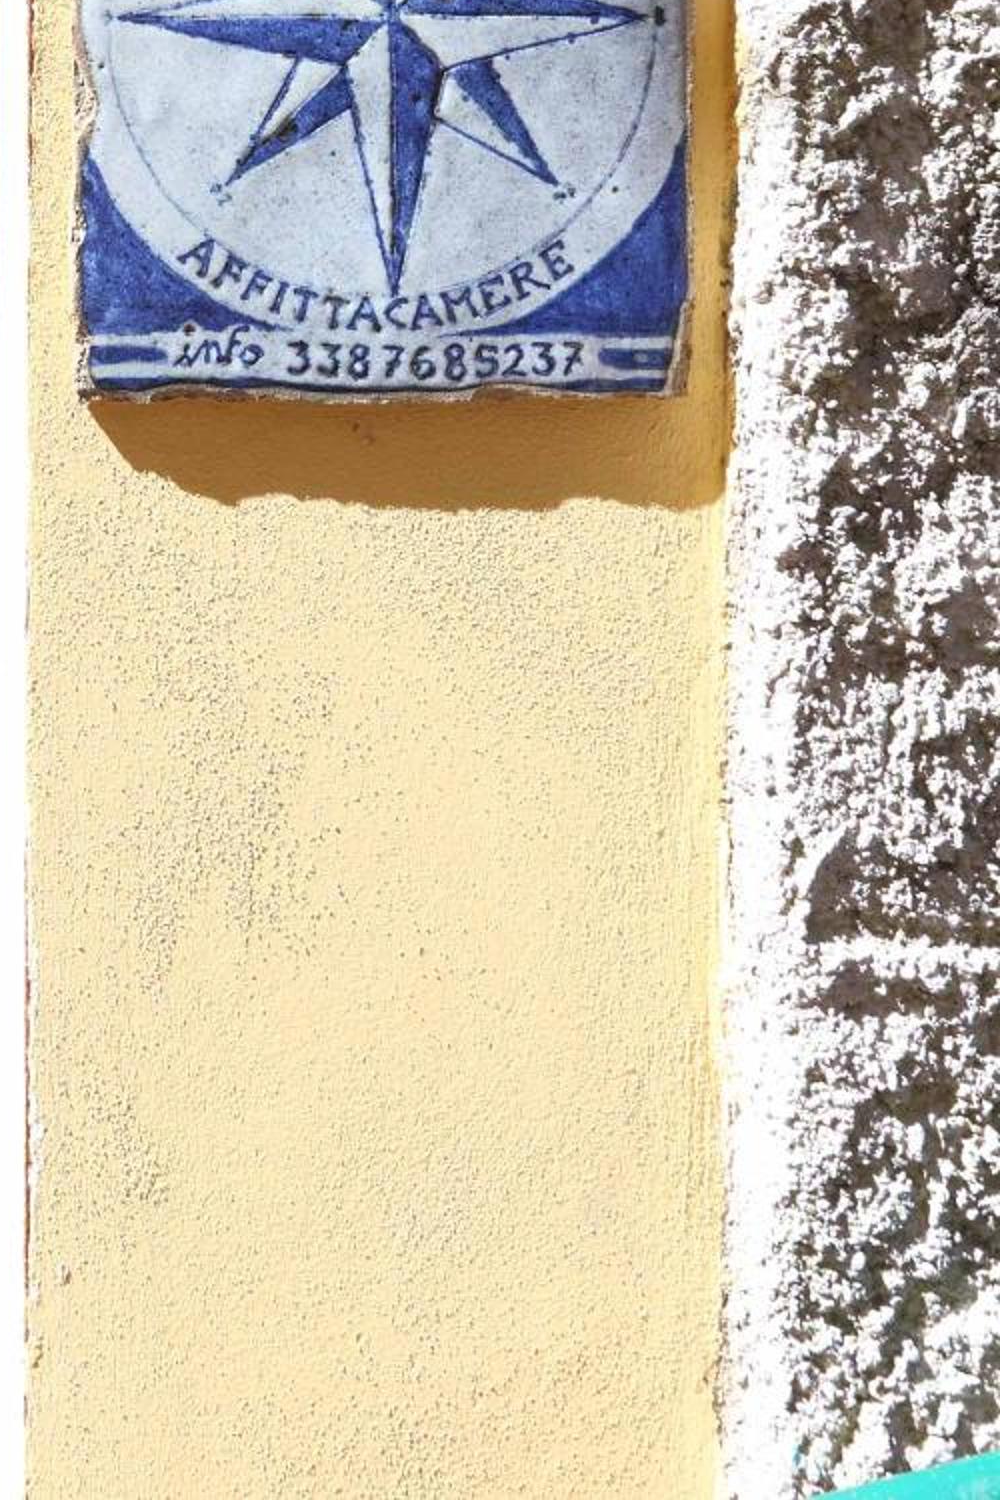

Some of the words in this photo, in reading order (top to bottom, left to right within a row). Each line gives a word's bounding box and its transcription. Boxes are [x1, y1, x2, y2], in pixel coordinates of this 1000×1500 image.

[176, 238, 576, 333] AFFITTACAMERE
[173, 323, 264, 367] info
[286, 340, 584, 381] 3387685237
